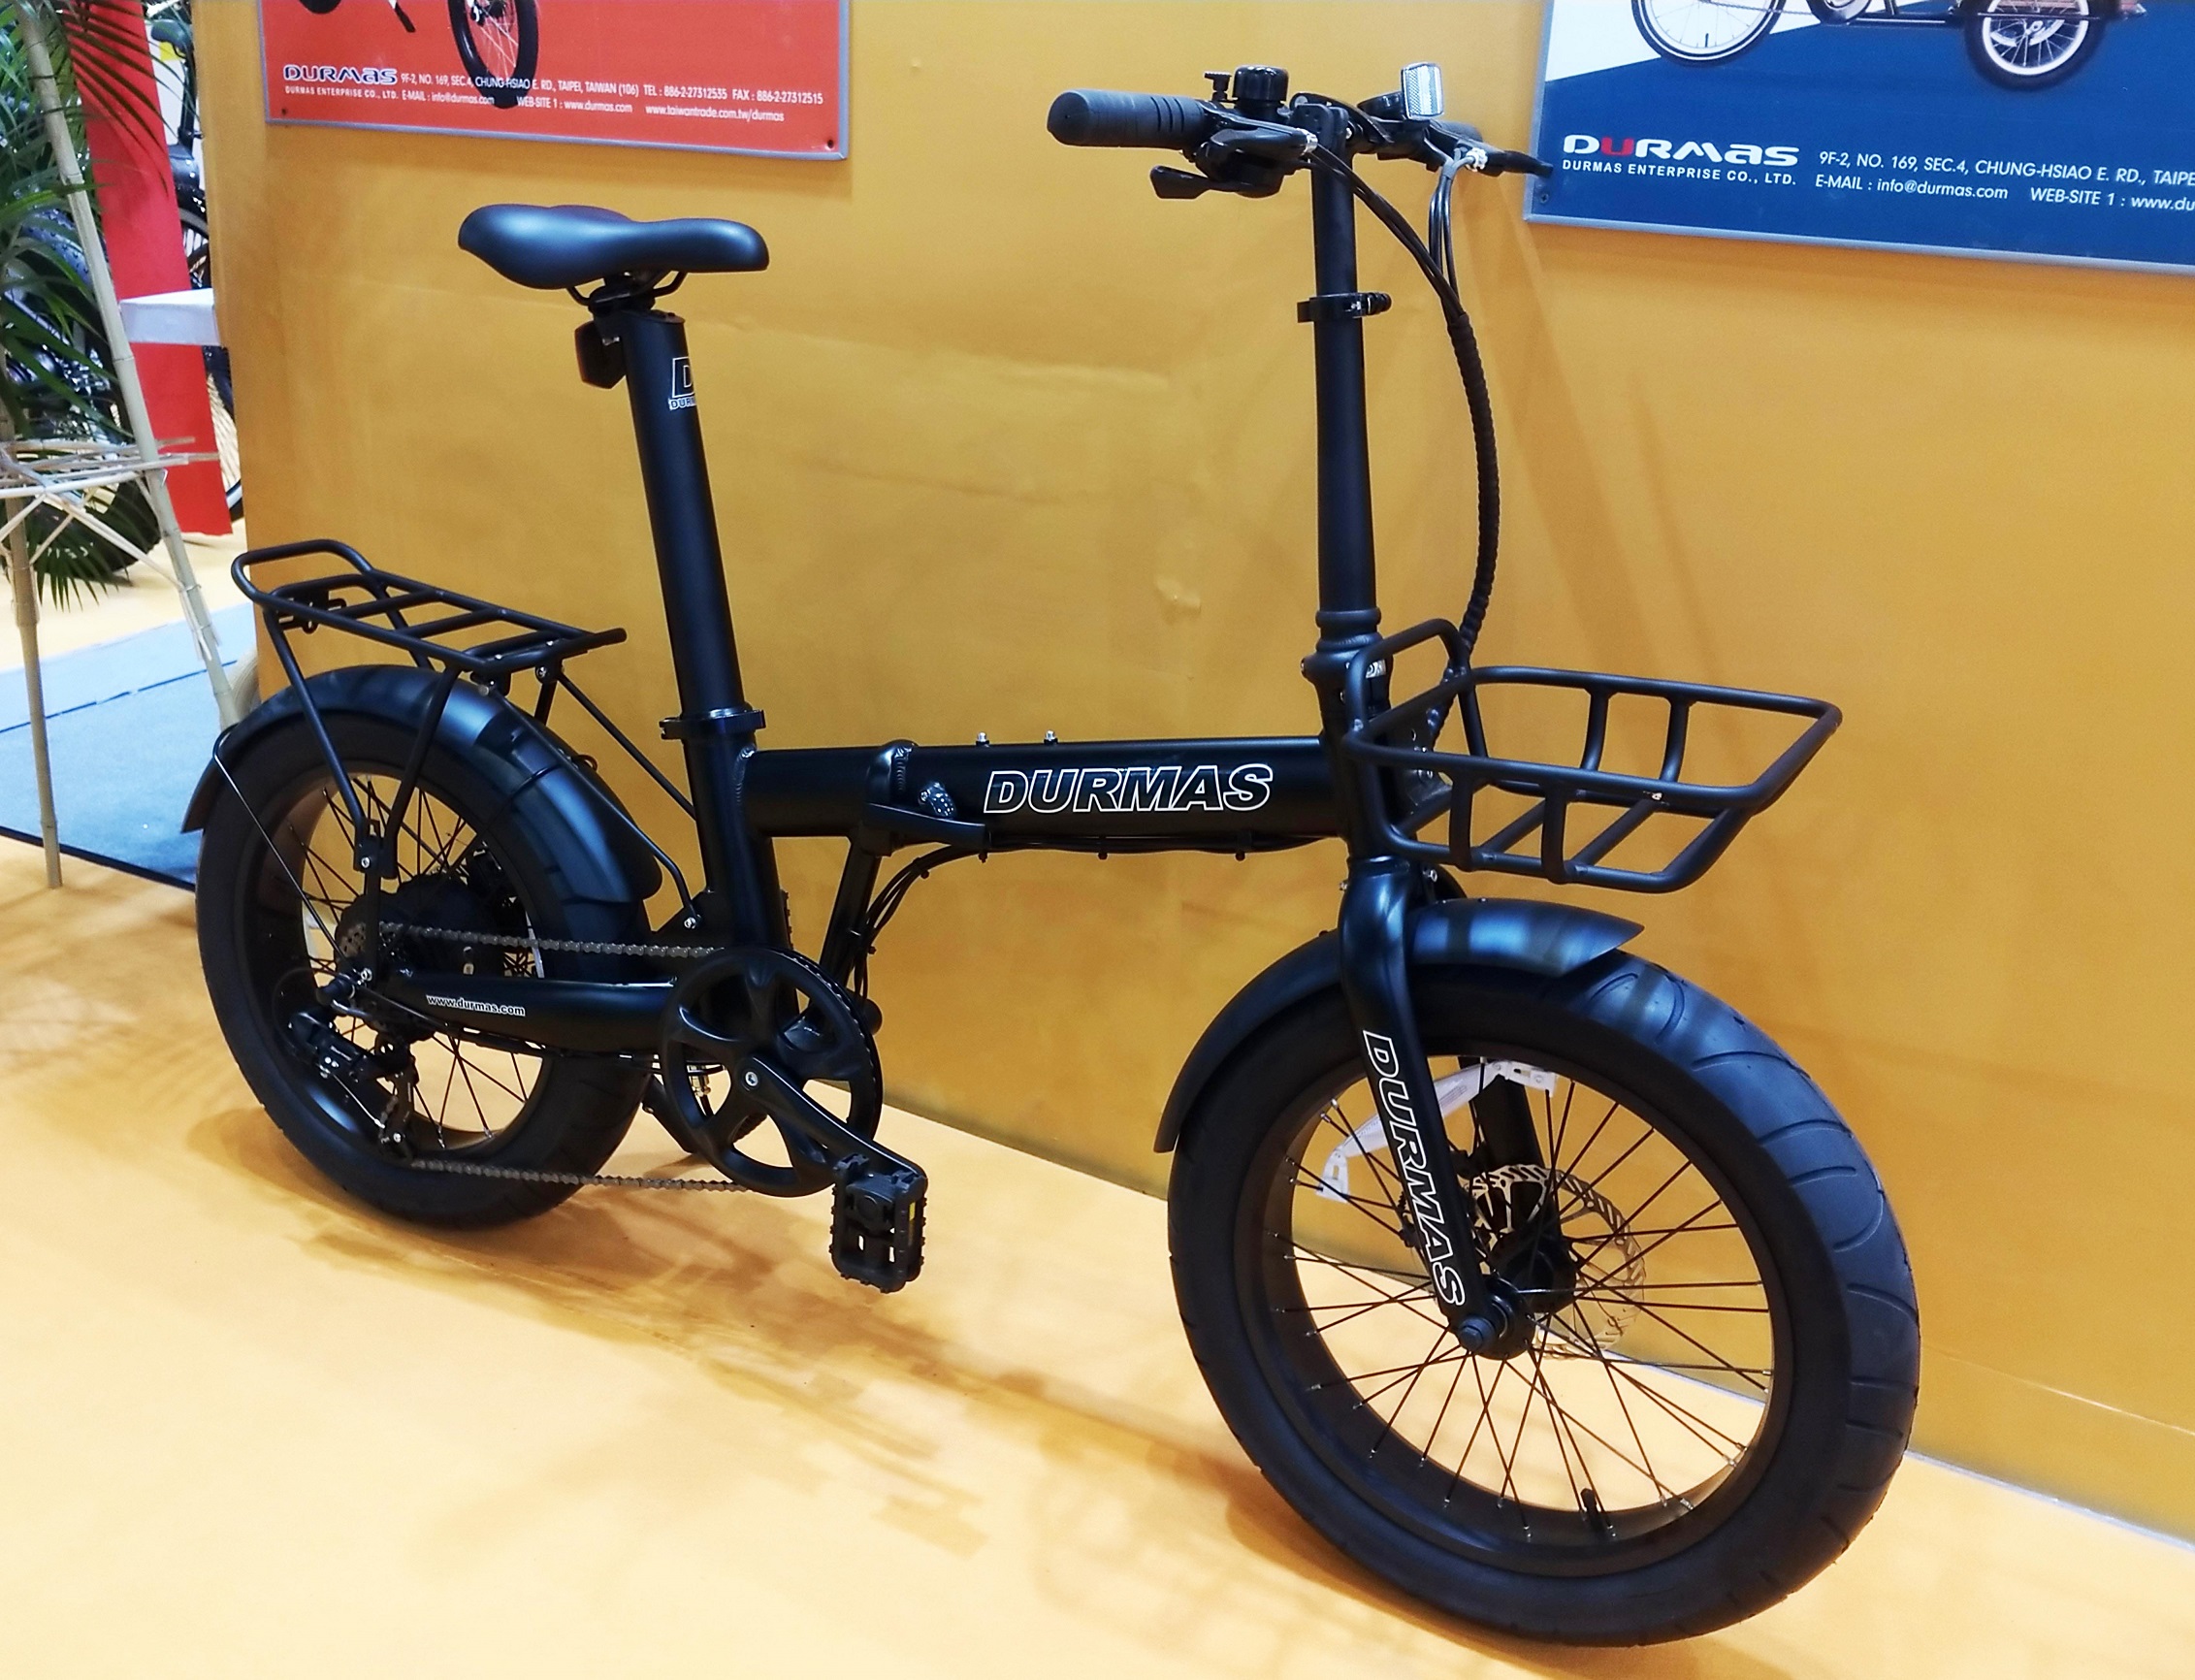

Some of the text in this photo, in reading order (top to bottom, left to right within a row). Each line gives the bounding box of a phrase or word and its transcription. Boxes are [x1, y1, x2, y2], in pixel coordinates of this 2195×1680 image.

[285, 85, 315, 95] DURMAS
[317, 87, 362, 98] ENTERPRISE
[382, 90, 399, 99] LTD.
[401, 73, 417, 85] 9F-2,
[419, 74, 433, 85] NO.
[436, 75, 449, 86] 169,
[475, 76, 531, 89] CHUNG-HSIAO
[558, 81, 583, 94] TAIPEI,
[585, 81, 617, 94] TAIWAN
[618, 83, 639, 97] (106)
[644, 84, 658, 96] TEL
[663, 85, 727, 100] 886-2-27312535
[732, 88, 751, 101] FAX
[757, 90, 823, 105] 886-2-27312515
[402, 90, 426, 101] E-MAIL
[432, 92, 495, 105] info@durmas.com
[517, 96, 551, 108] WEB-SITE
[565, 100, 632, 113] www.durmas.com
[645, 105, 785, 122] www.taiwantrade.com.tw/durmas
[1563, 159, 1796, 185] DURMAS ENTERPRISE CO., LTD.
[1819, 150, 1851, 169] 9F-2,
[1856, 152, 1884, 168] NO.
[1891, 155, 1919, 173] 169,
[1923, 156, 1969, 176] SEC.4,
[1975, 159, 2092, 180] CHUNG-HSIAO
[2096, 166, 2110, 181] E.
[2115, 168, 2147, 186] RD.,
[1815, 174, 1863, 190] E-MAIL
[1877, 178, 2009, 200] info@durmas.com
[2030, 186, 2102, 206] WEB-SITE
[2108, 192, 2115, 206] 1
[983, 762, 1275, 814] DURMAS
[425, 994, 527, 1018] www.durmas.com
[1362, 1029, 1466, 1307] DURMAS
